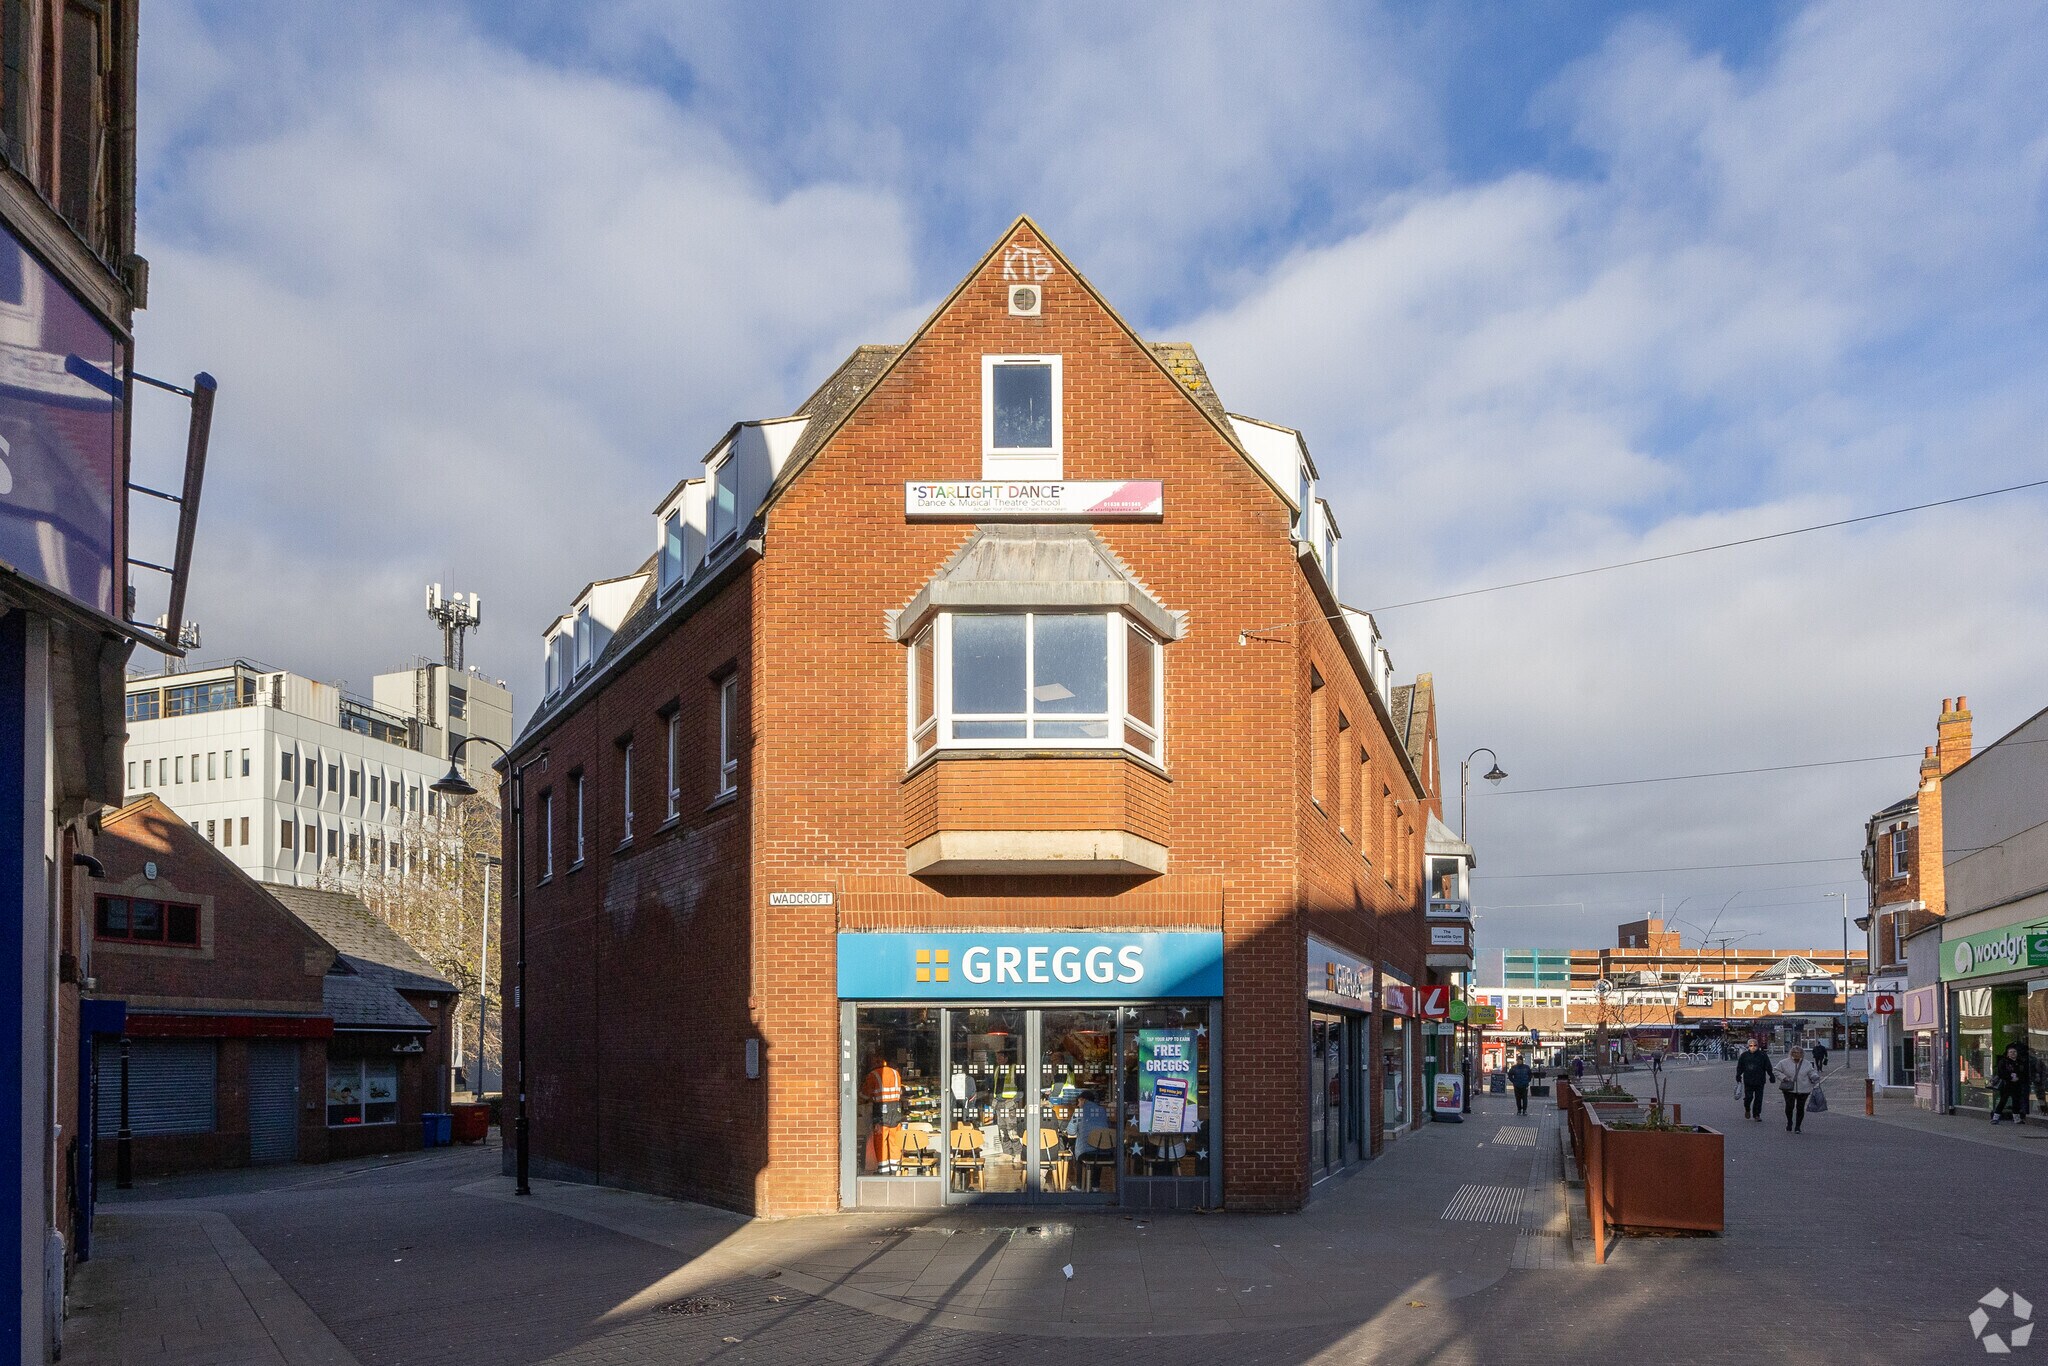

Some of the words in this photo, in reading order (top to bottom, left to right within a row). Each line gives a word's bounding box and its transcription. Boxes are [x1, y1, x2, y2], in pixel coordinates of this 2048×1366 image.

[918, 486, 1003, 498] STARLIGHT
[1008, 486, 1060, 498] DANCE
[918, 499, 946, 507] Dance
[949, 499, 956, 507] &
[958, 499, 991, 507] Musical
[994, 499, 1029, 507] Theatre
[1031, 499, 1061, 507] School
[772, 893, 831, 904] WADCROFT
[961, 946, 1145, 984] GREGGS
[1687, 995, 1712, 1006] JAMIE'S
[1153, 1044, 1182, 1057] FREE
[1146, 1059, 1190, 1072] GREGGS
